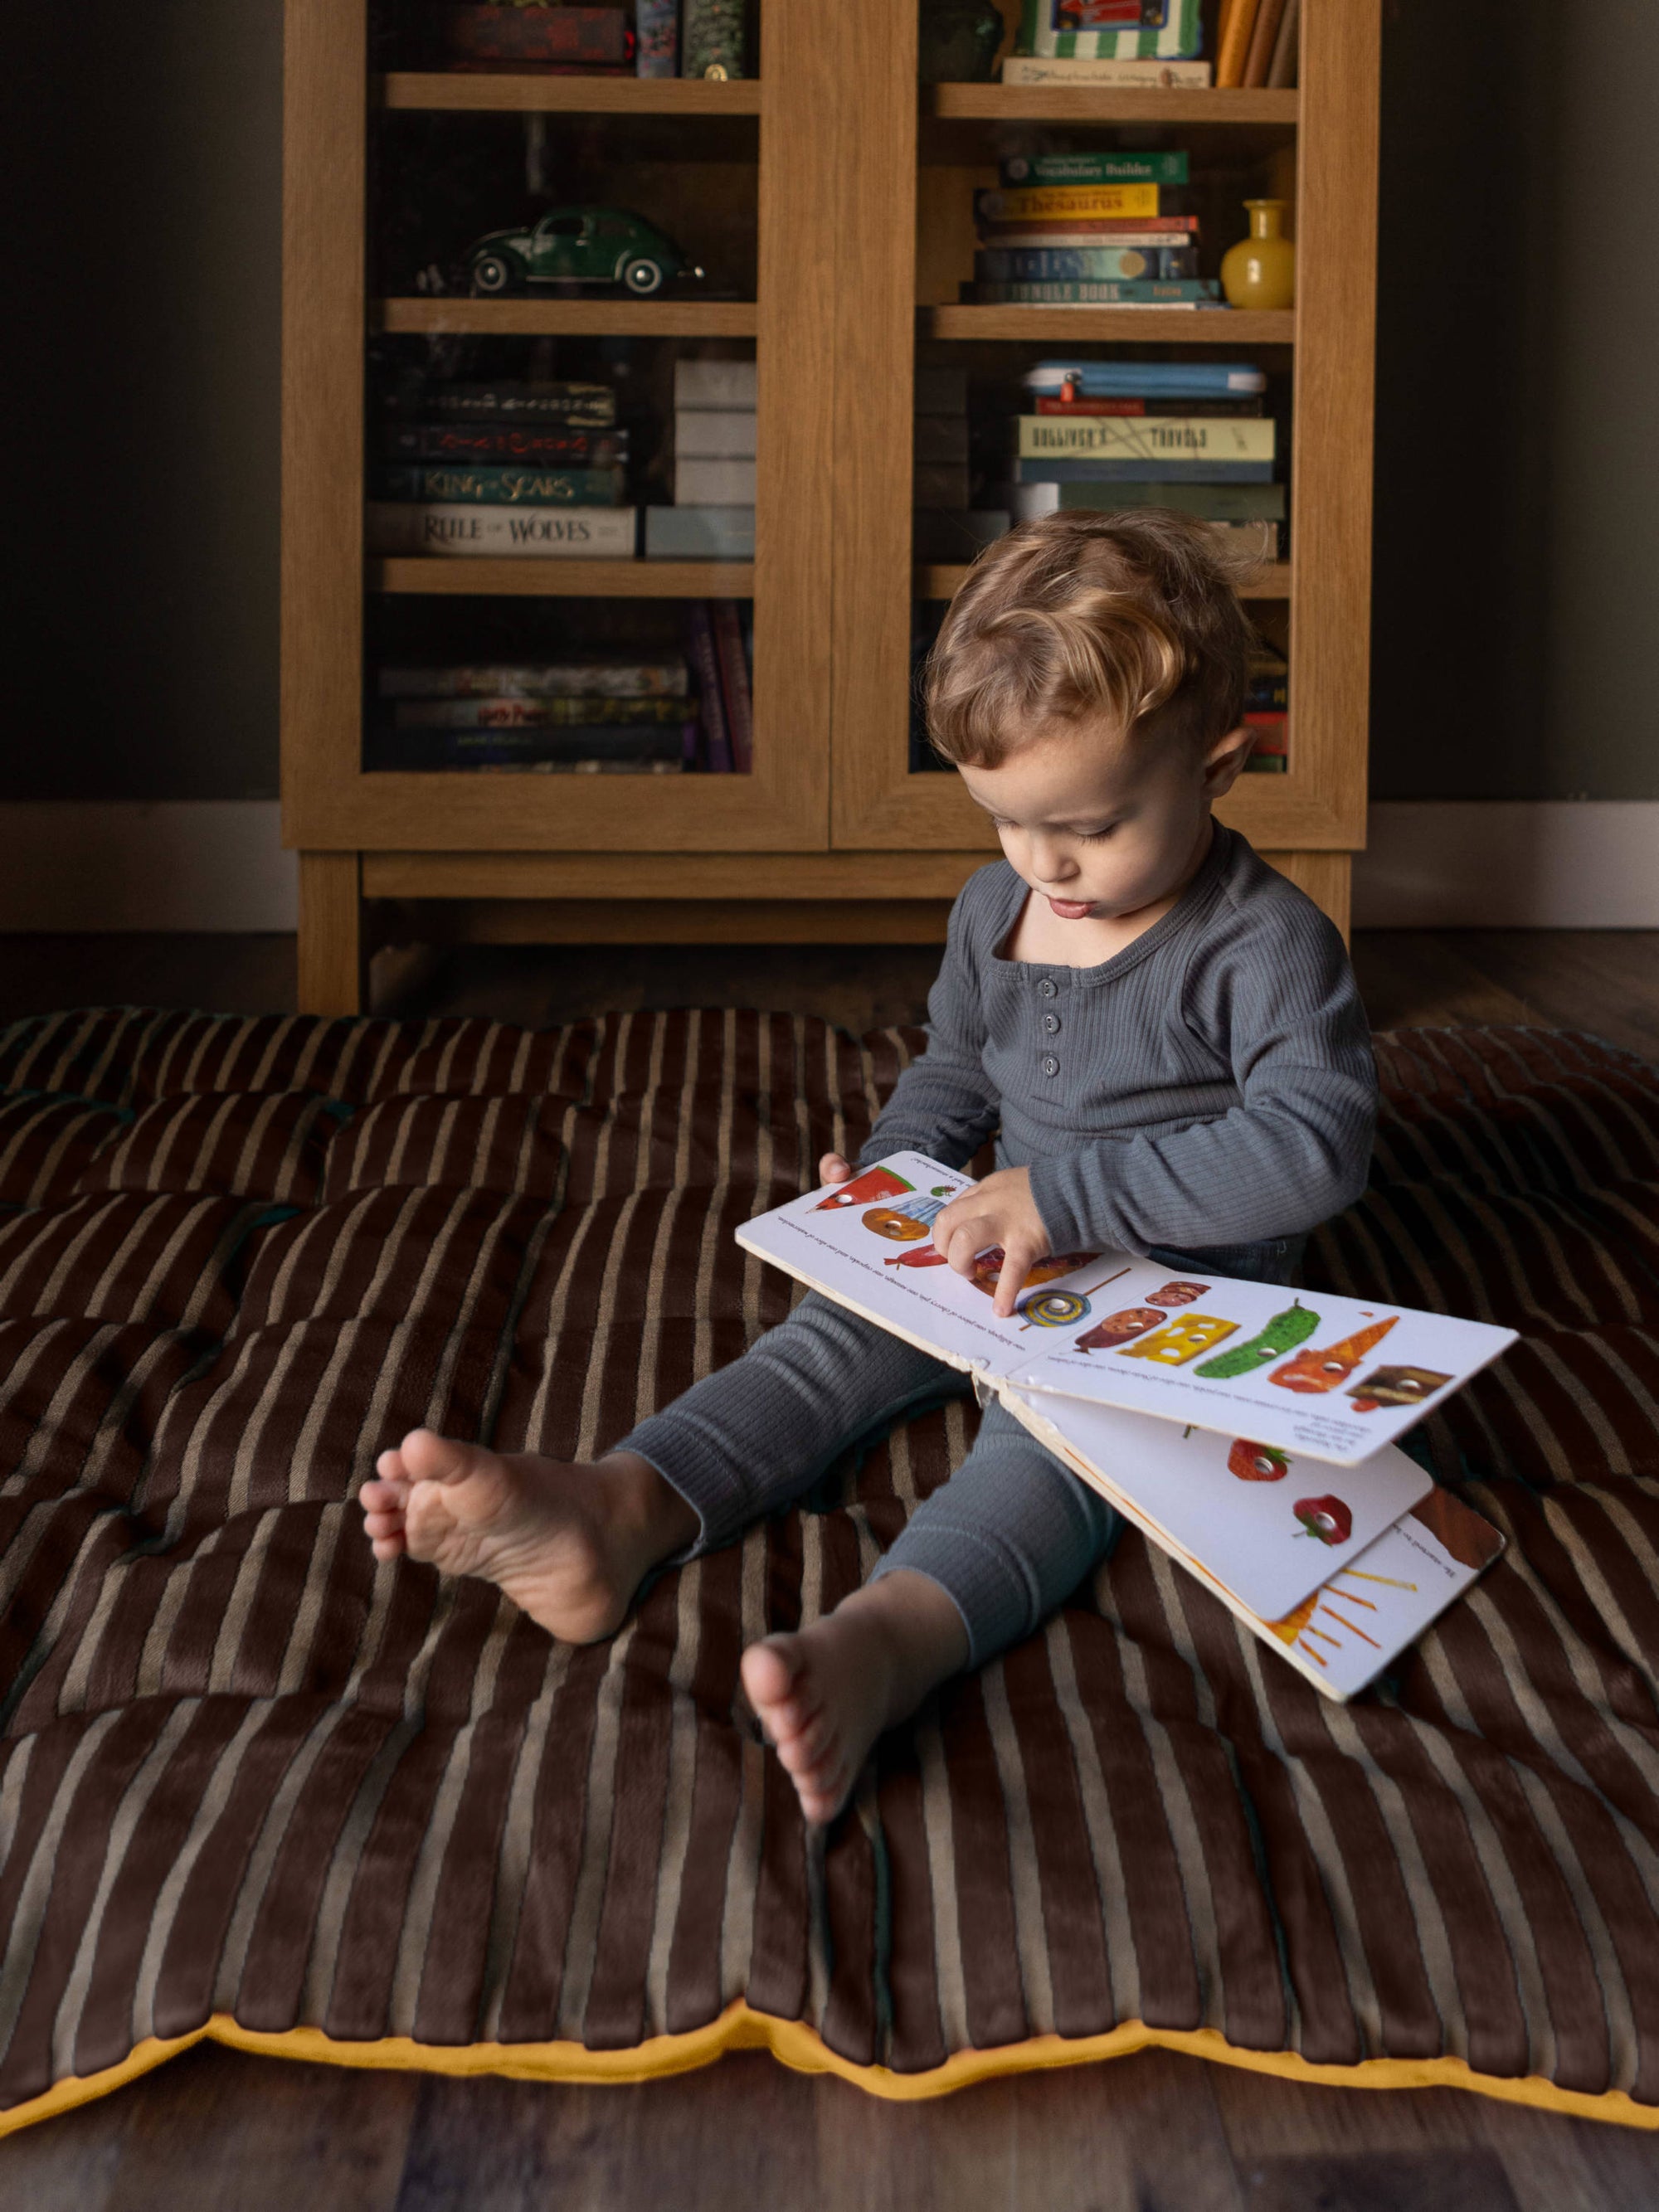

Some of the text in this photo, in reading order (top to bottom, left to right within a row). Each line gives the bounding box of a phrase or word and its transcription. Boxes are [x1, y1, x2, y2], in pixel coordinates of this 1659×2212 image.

[1034, 162, 1153, 177] Vocabulary Builder
[1018, 194, 1124, 213] Thesaurus
[1078, 283, 1120, 301] BOOK
[1151, 426, 1208, 449] TRAVELS
[424, 471, 484, 498] KING
[500, 471, 575, 501] SCARS
[424, 514, 483, 542] RULE
[508, 511, 591, 544] WOLVES
